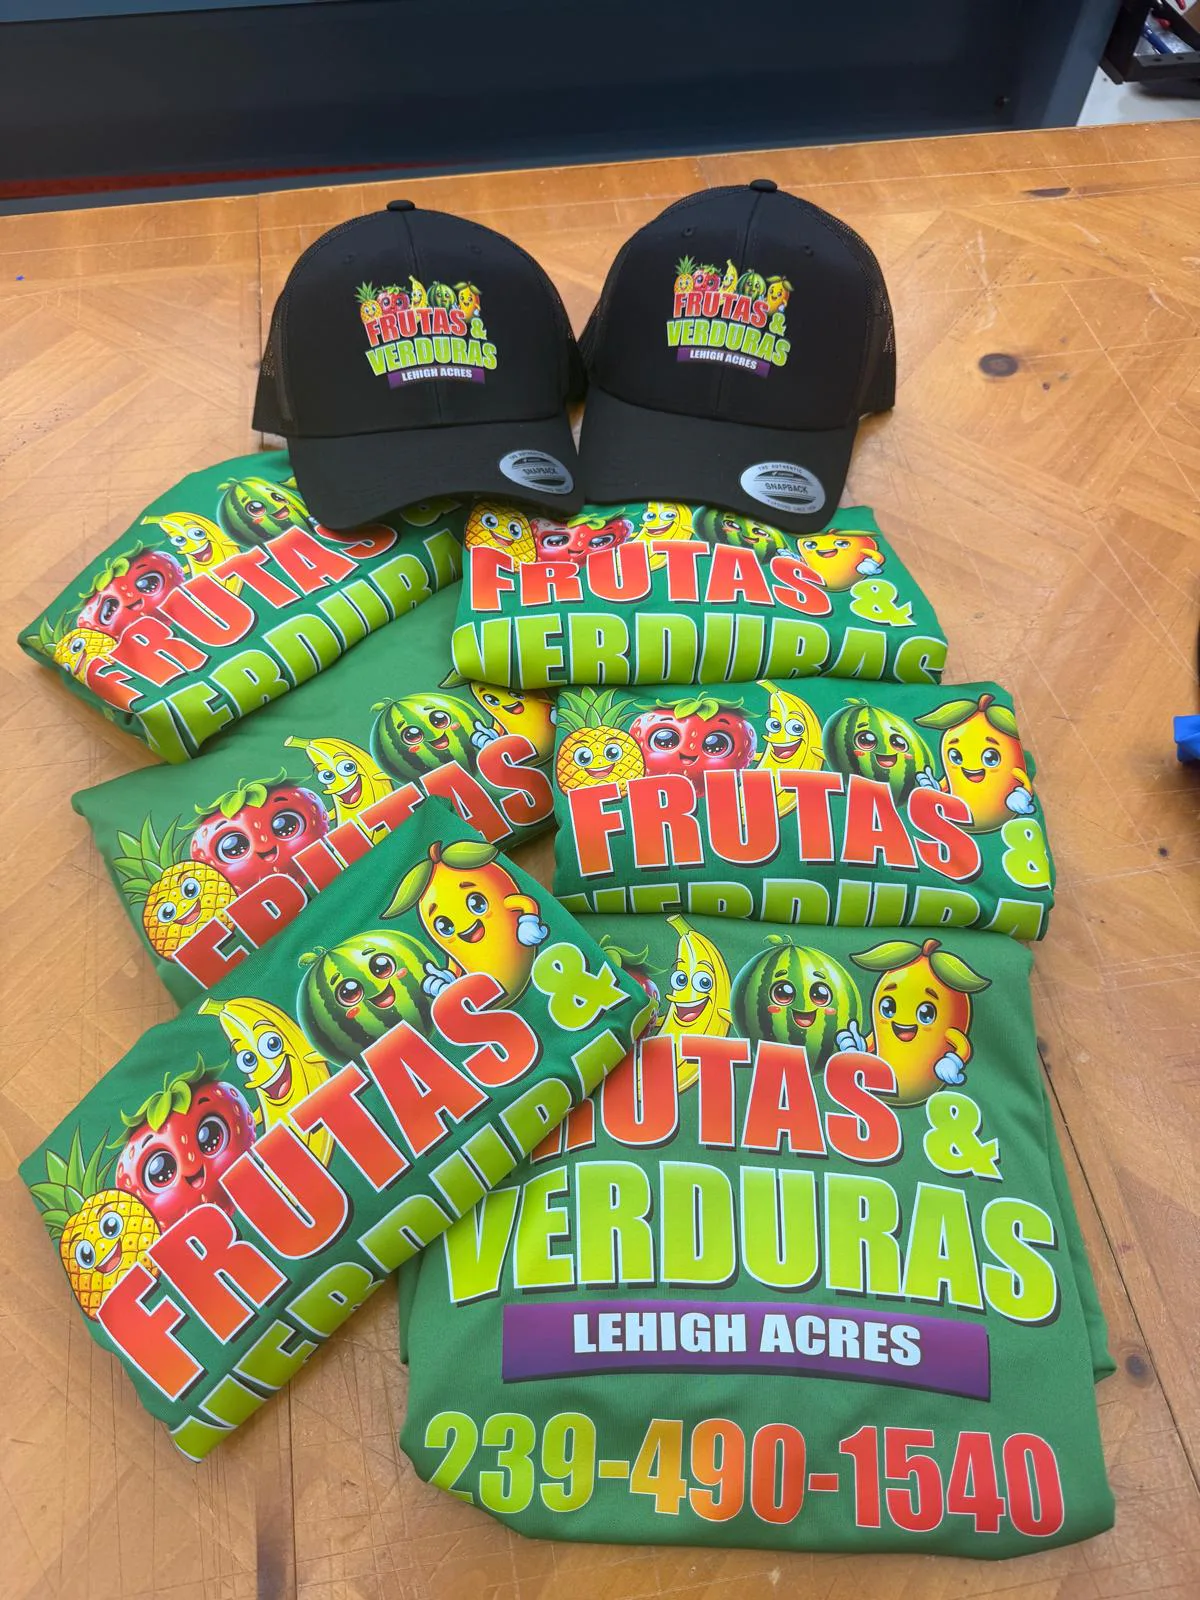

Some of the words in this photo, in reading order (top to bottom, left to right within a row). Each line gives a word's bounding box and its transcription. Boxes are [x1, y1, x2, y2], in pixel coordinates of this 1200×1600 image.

[364, 307, 467, 347] FRUTAS
[470, 317, 487, 340] &
[673, 290, 769, 328] FRUTAS
[769, 312, 787, 337] &
[365, 336, 497, 376] VERDURAS
[666, 318, 791, 367] VERDURAS
[690, 349, 724, 362] LEHIGH
[725, 353, 758, 370] ACRES
[401, 368, 439, 382] LEHIGH
[440, 367, 473, 379] ACRES
[764, 482, 809, 495] SNAPBACK
[470, 539, 832, 616] FRUTAS
[850, 579, 918, 627] &
[567, 768, 983, 881] FRUTAS
[530, 1033, 903, 1164] UTAS
[922, 1090, 1003, 1182] &
[98, 972, 539, 1402] FRUTAS
[531, 942, 632, 1031] &
[444, 1160, 1058, 1321] VERDURAS
[572, 1312, 748, 1354] LEHIGH
[759, 1320, 922, 1368] ACRES
[424, 1410, 1065, 1538] 239-490-1540
